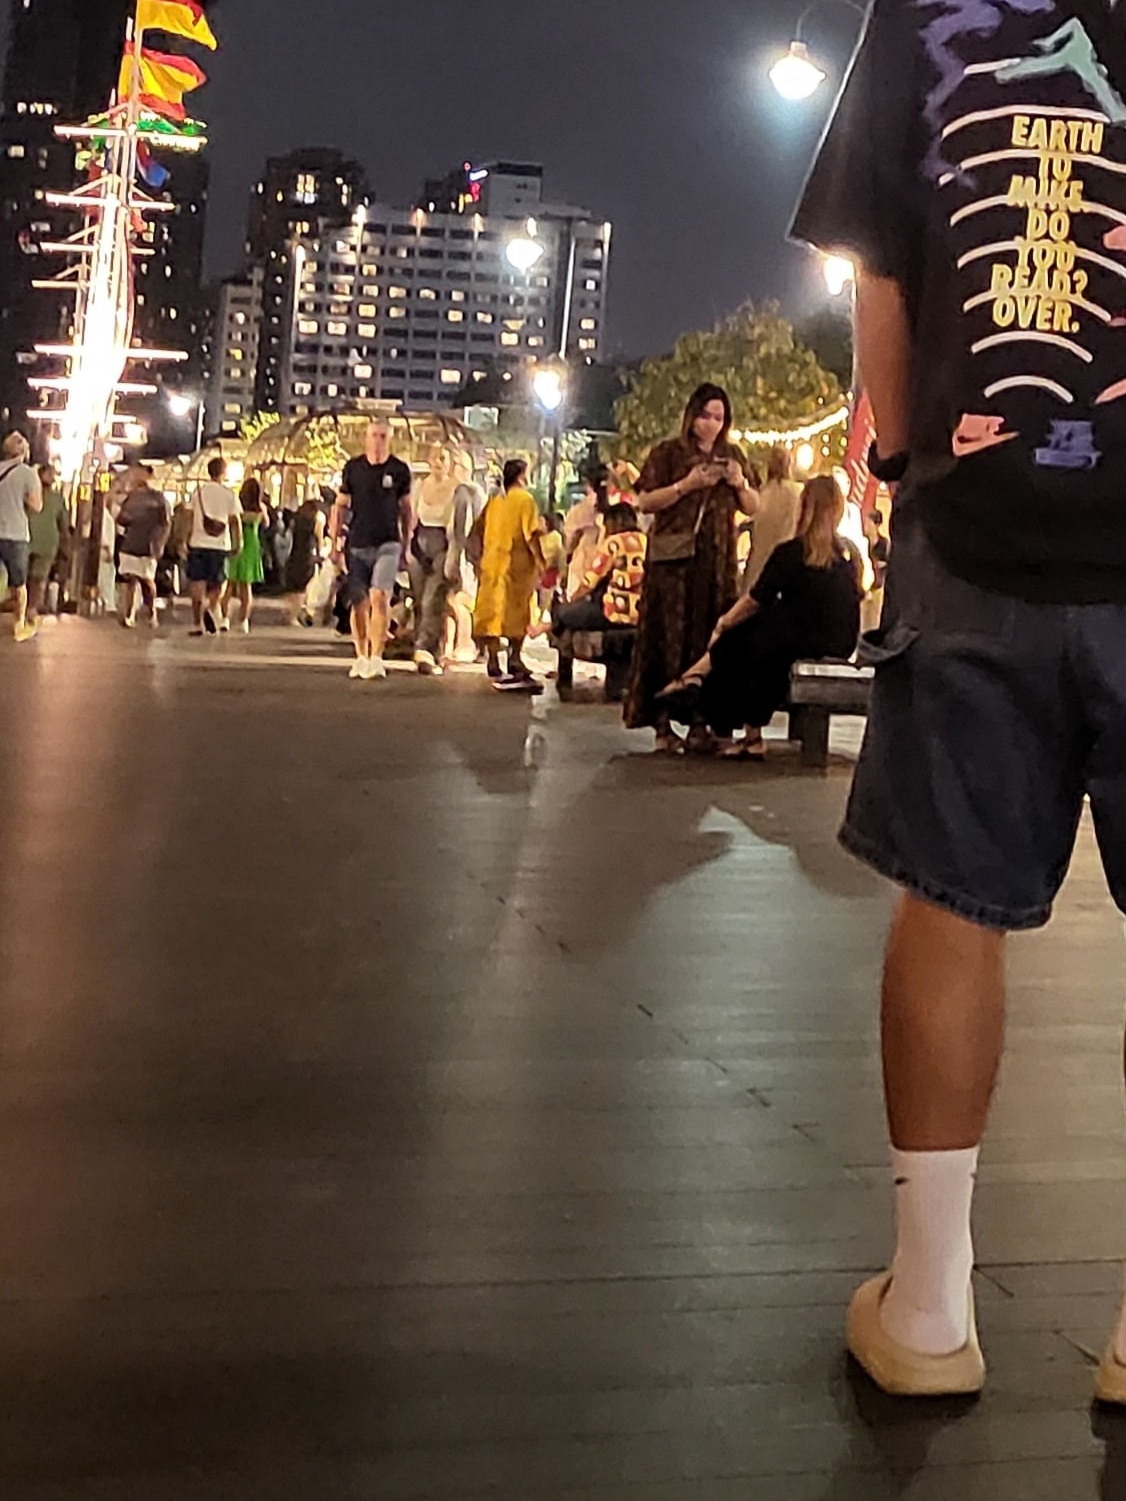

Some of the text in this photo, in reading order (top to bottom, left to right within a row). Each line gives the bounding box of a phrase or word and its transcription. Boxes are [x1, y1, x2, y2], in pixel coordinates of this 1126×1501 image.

[1011, 115, 1104, 154] EARTH
[1038, 149, 1072, 182] TO
[1027, 208, 1070, 241] DO
[1014, 236, 1076, 271] YOU
[992, 264, 1088, 299] READ?
[993, 297, 1080, 334] OVER.
